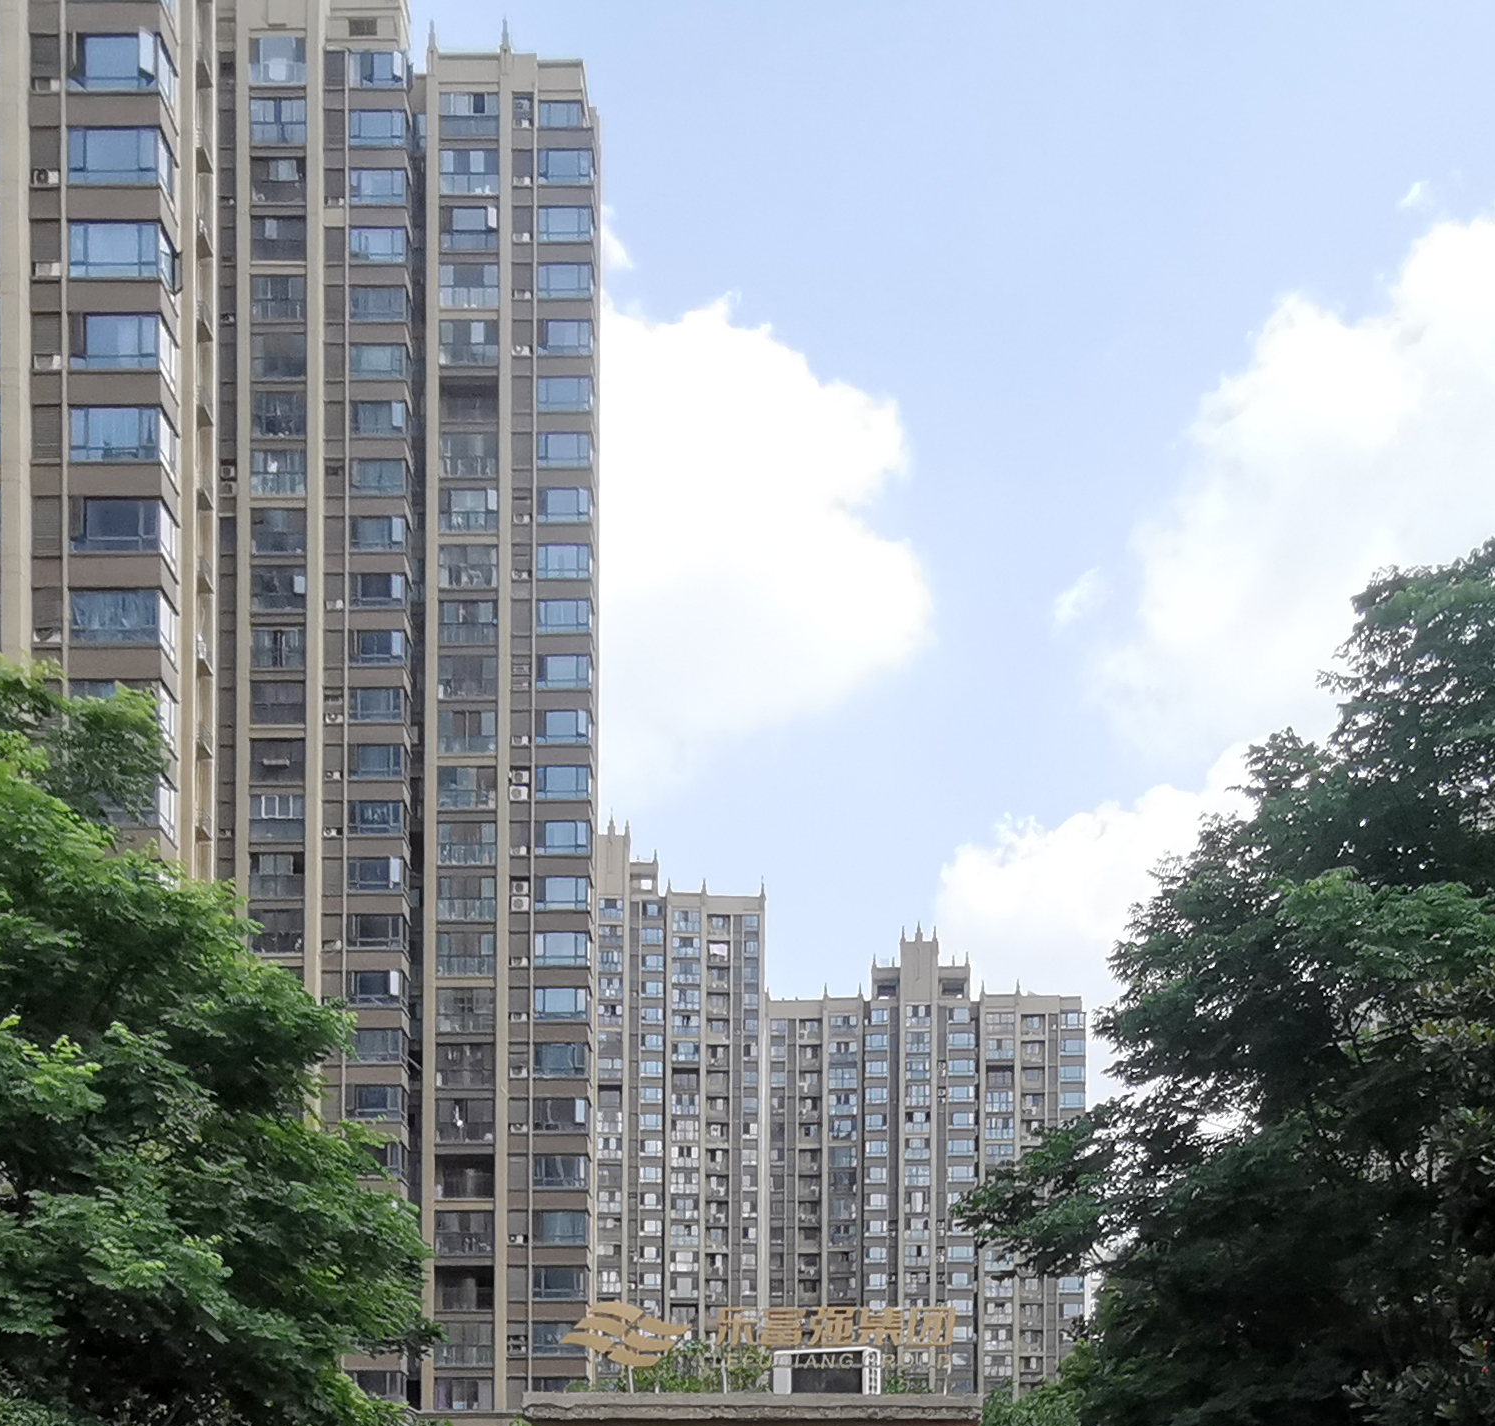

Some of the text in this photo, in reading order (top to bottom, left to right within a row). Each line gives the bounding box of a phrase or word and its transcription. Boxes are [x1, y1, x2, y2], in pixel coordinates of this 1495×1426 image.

[716, 1306, 955, 1346] 乐富强集团
[712, 1353, 854, 1369] LEFUIANG
